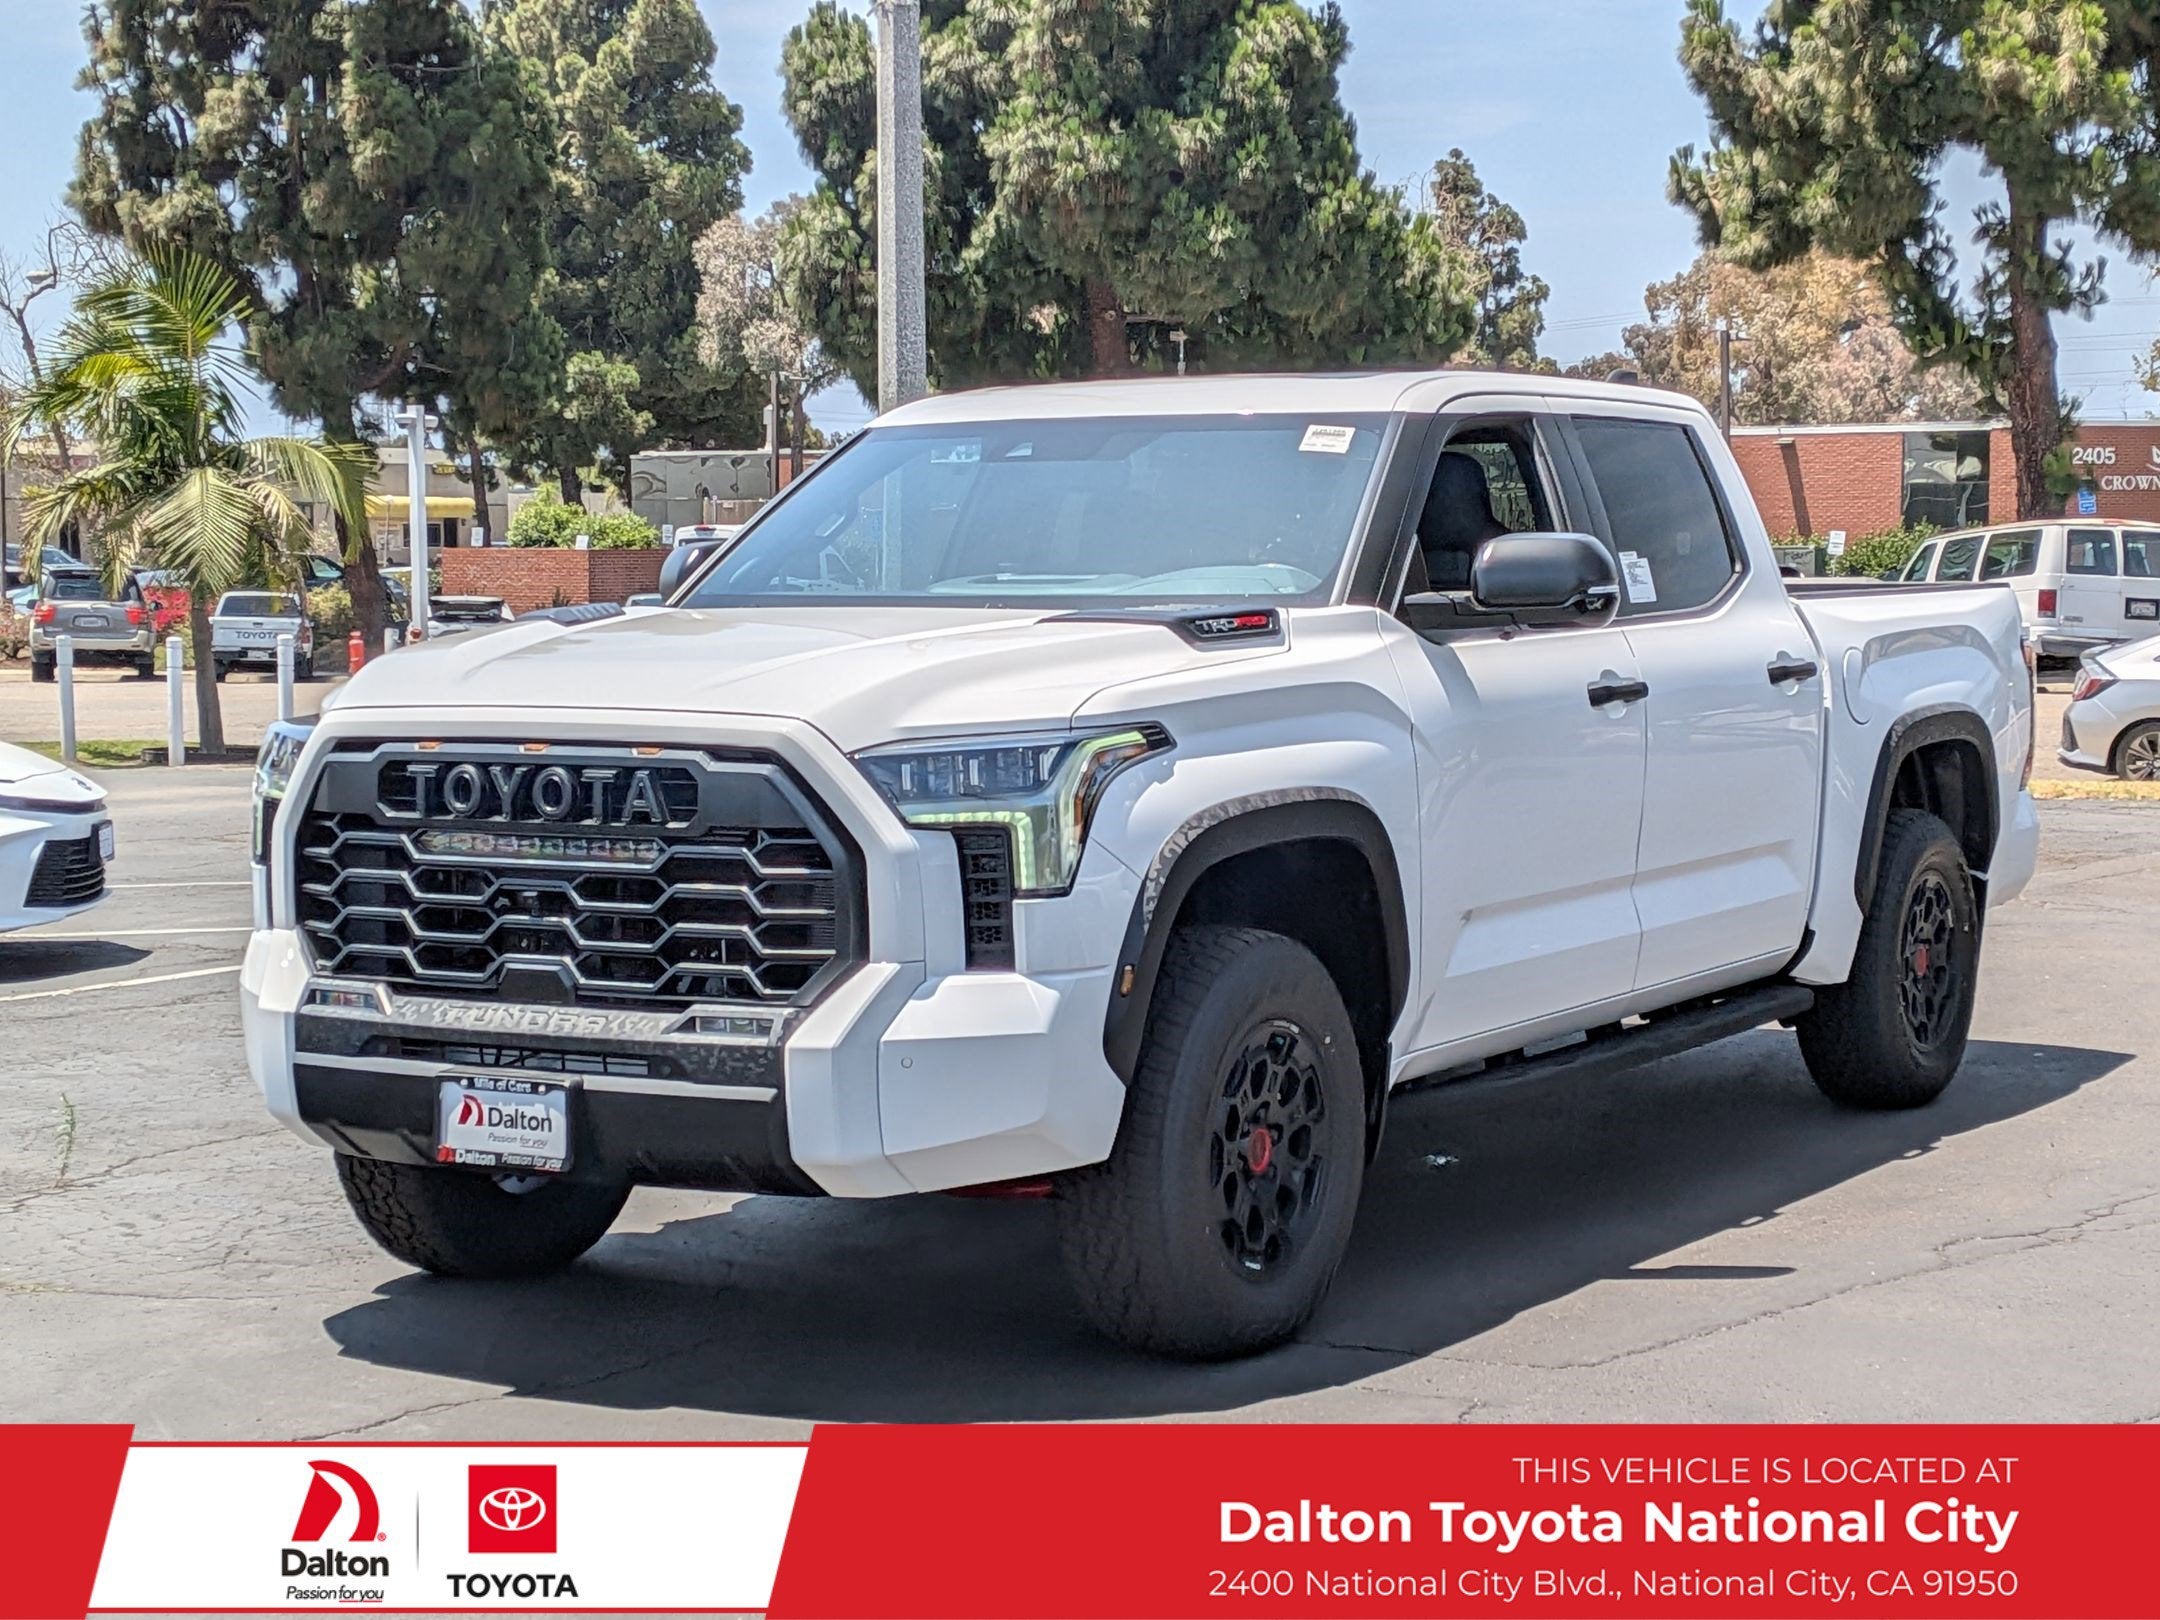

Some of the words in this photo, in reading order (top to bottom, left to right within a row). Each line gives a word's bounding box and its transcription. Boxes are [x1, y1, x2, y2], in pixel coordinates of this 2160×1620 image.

[2072, 447, 2116, 465] 2405
[404, 763, 667, 823] TOYOTA
[445, 1002, 608, 1034] TUNDRA
[487, 1107, 552, 1133] Dalton
[455, 1149, 496, 1166] Dalton
